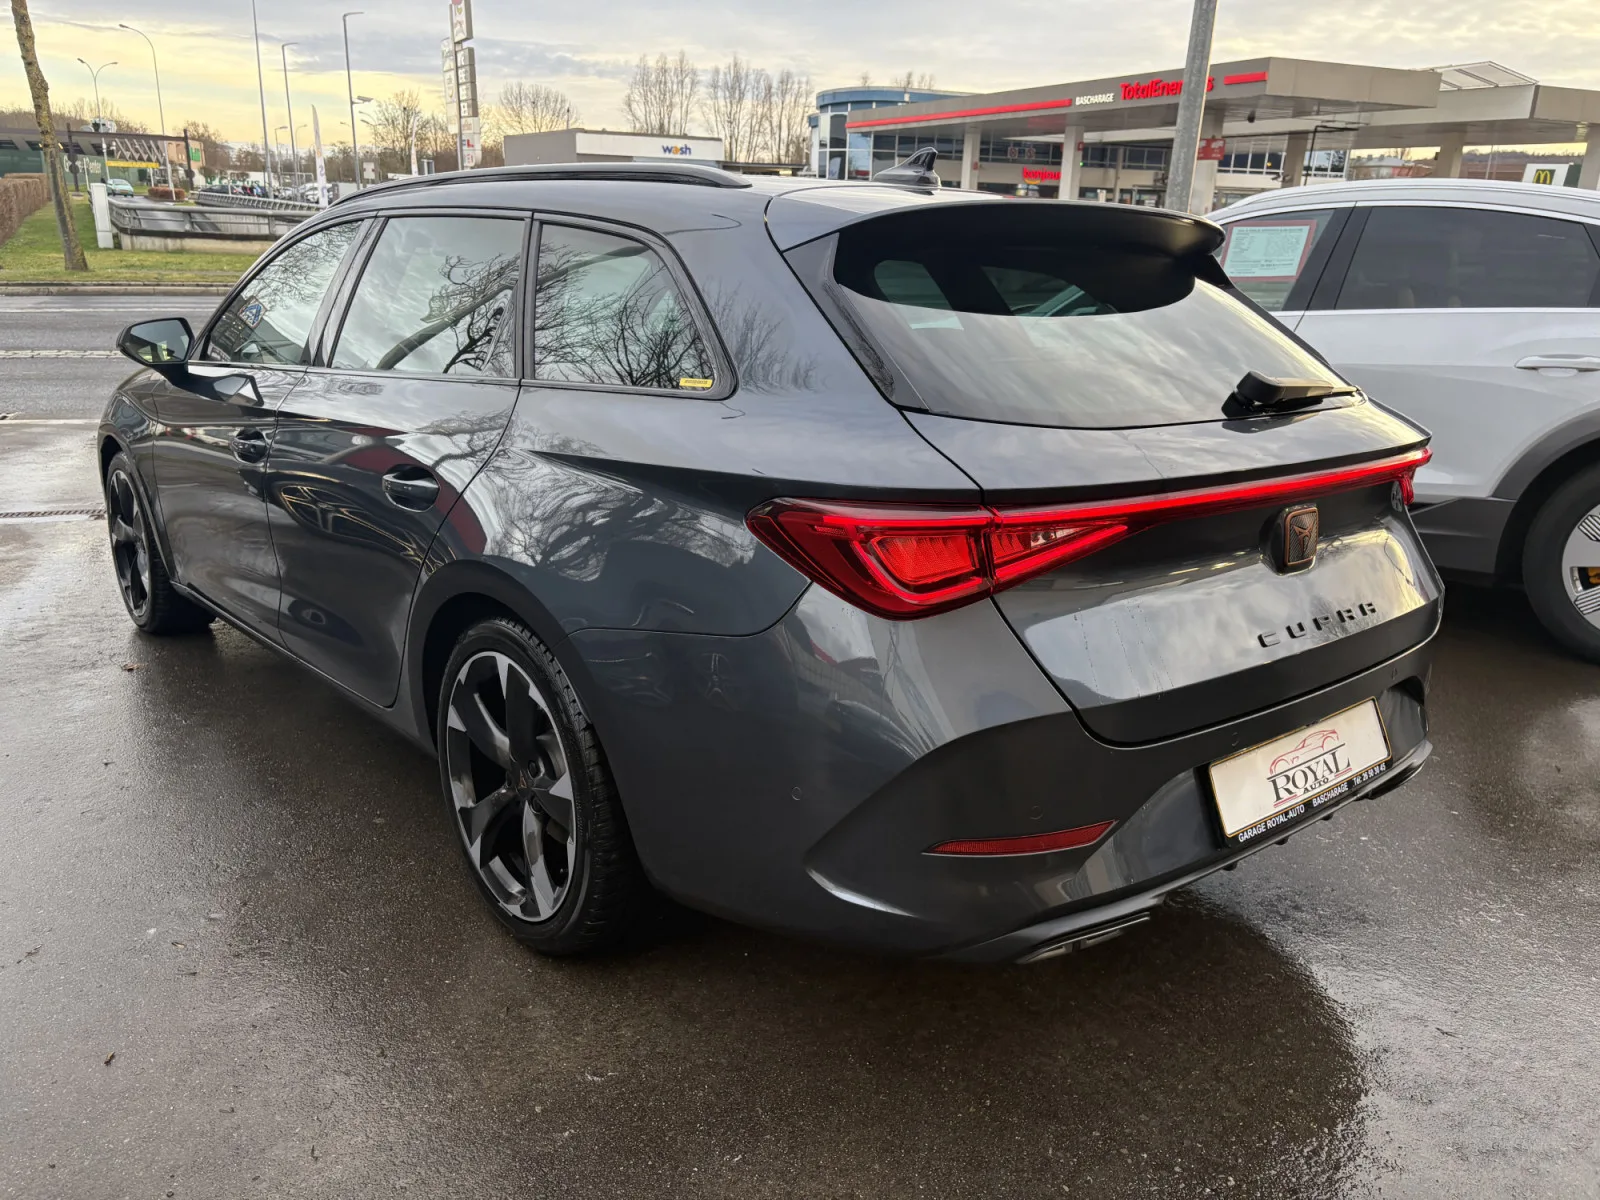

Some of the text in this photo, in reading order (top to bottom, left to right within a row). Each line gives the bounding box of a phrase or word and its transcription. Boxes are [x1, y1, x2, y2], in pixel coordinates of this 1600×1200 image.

[1119, 76, 1214, 101] TotalEners
[1075, 93, 1115, 106] BASCHARAGE
[662, 144, 692, 156] wash
[1268, 749, 1351, 802] ROYAL
[1303, 777, 1330, 795] AUTO
[1238, 822, 1267, 843] GARAGE
[1266, 804, 1305, 830] ROYAL-AUTO
[1312, 782, 1349, 808] BASCHARAGE
